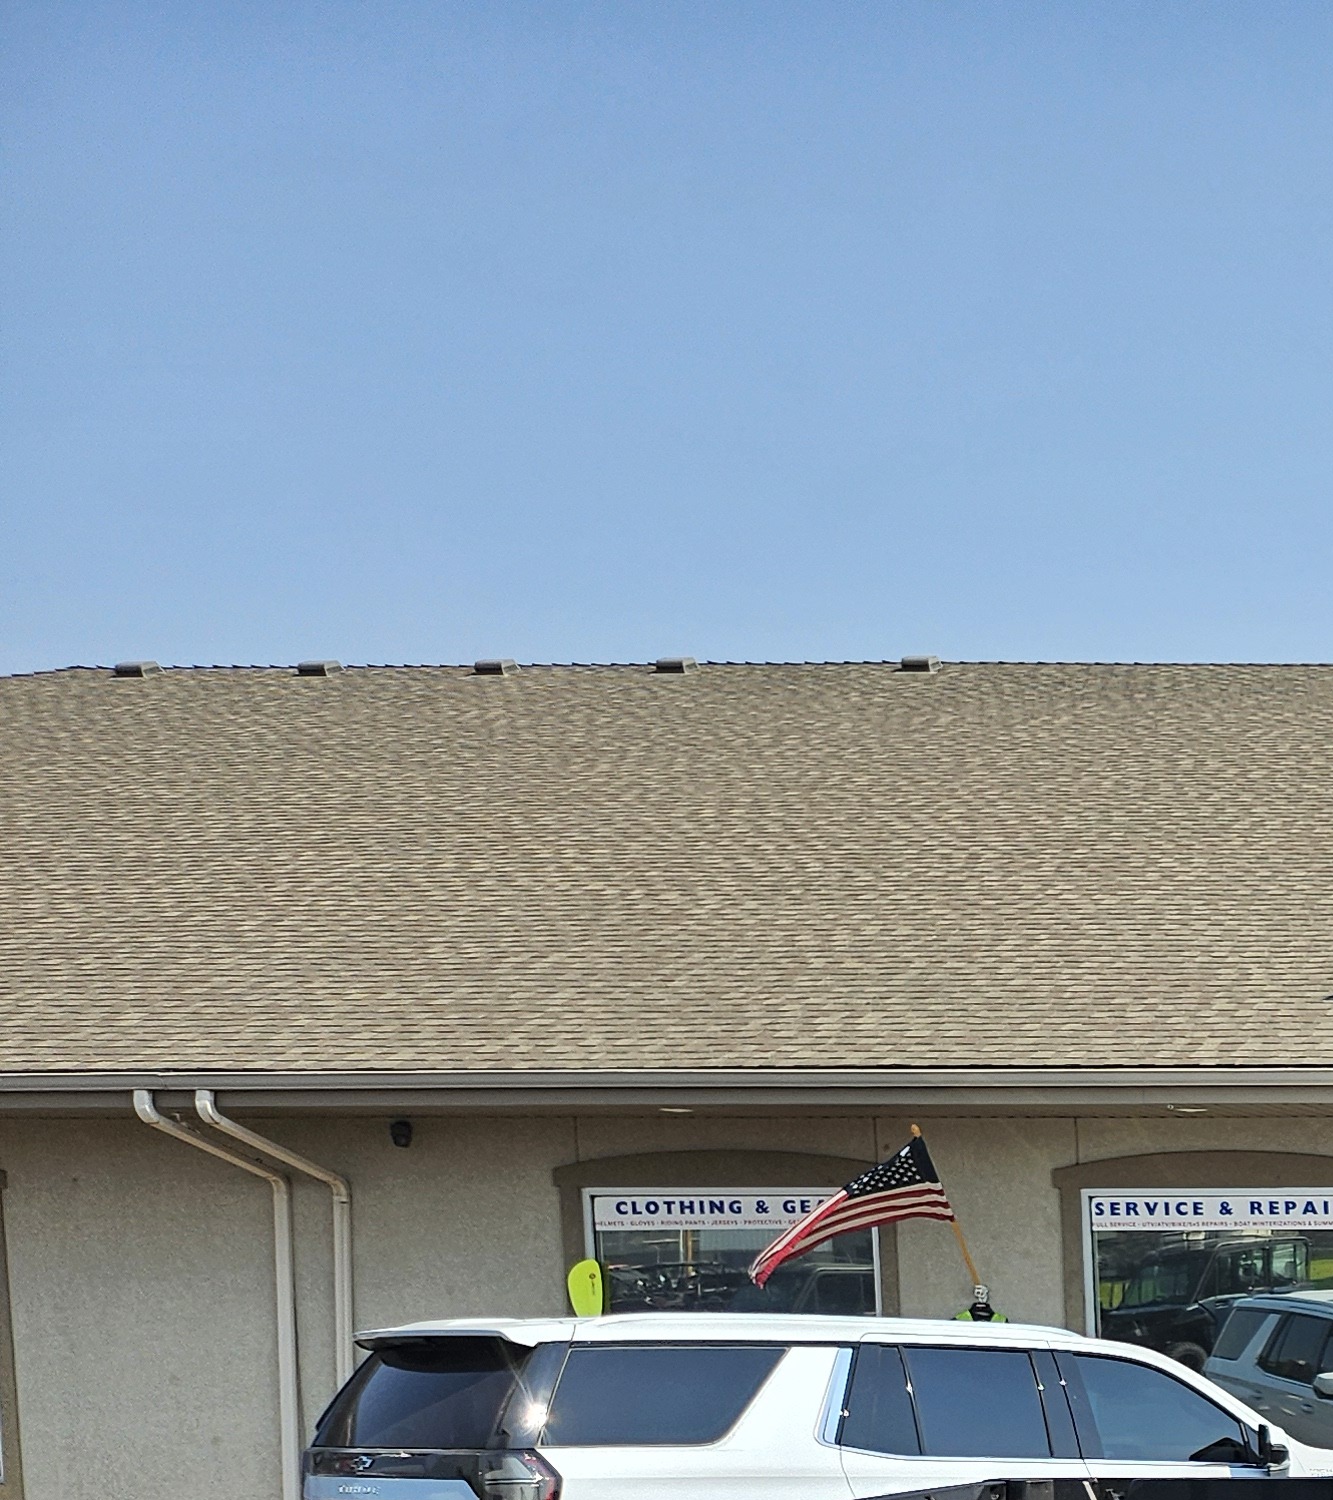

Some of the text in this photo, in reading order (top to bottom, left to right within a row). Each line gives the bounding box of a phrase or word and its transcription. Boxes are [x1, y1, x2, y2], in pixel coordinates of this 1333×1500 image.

[615, 1199, 824, 1215] CLOTHING & GE
[1094, 1201, 1204, 1216] SERVICE
[1219, 1201, 1233, 1215] &
